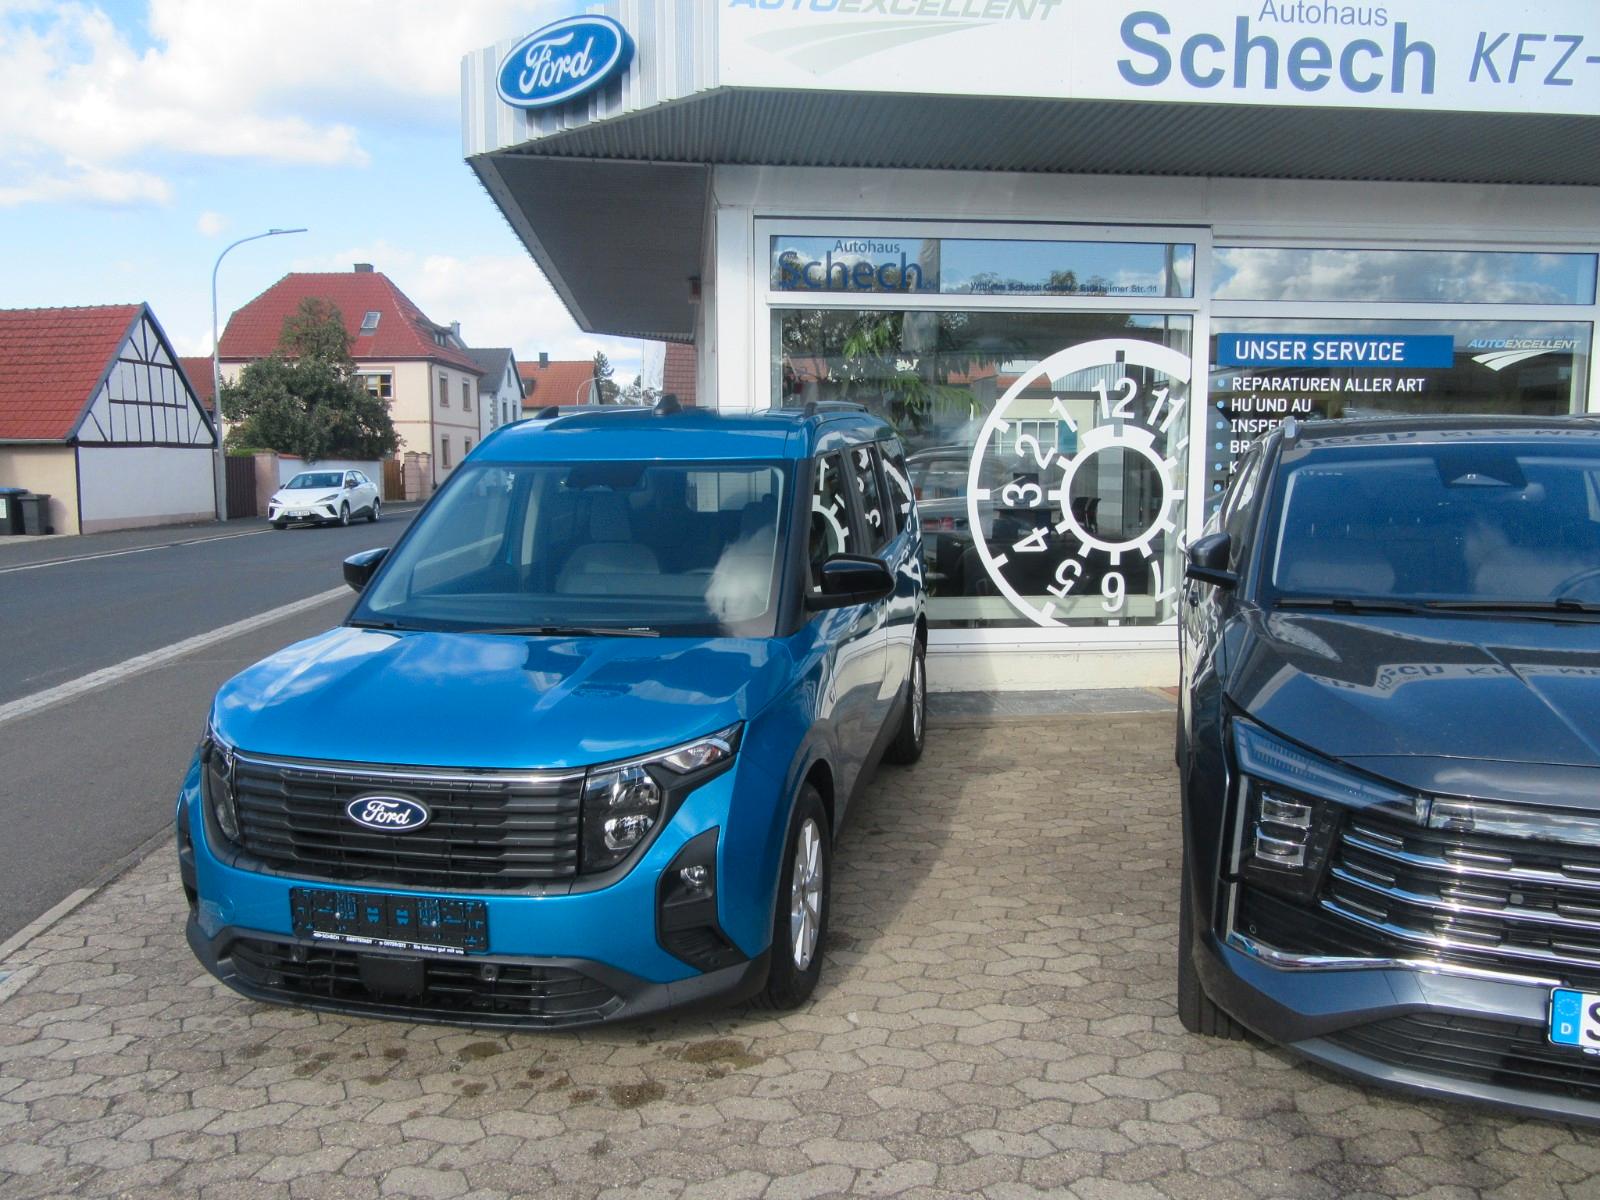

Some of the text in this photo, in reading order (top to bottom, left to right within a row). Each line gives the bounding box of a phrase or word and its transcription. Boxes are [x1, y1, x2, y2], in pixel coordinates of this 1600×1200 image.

[1259, 0, 1388, 26] Autohaus
[519, 32, 593, 94] Ford
[1117, 11, 1437, 95] Schech
[834, 239, 900, 254] Autohaus
[778, 250, 922, 289] Schech
[1235, 340, 1405, 361] UNSER SERVICE
[1468, 338, 1581, 349] AUTOEXCELLENT
[1232, 377, 1425, 392] REPARATUREN ALLER ART
[1091, 377, 1137, 419] 12
[1231, 398, 1311, 412] HU UND AU
[1230, 418, 1282, 433] INSPE
[1015, 434, 1057, 470] 2
[1002, 483, 1042, 507] 3
[1012, 526, 1049, 553] 4
[362, 800, 414, 825] Ford
[1561, 1022, 1571, 1034] D
